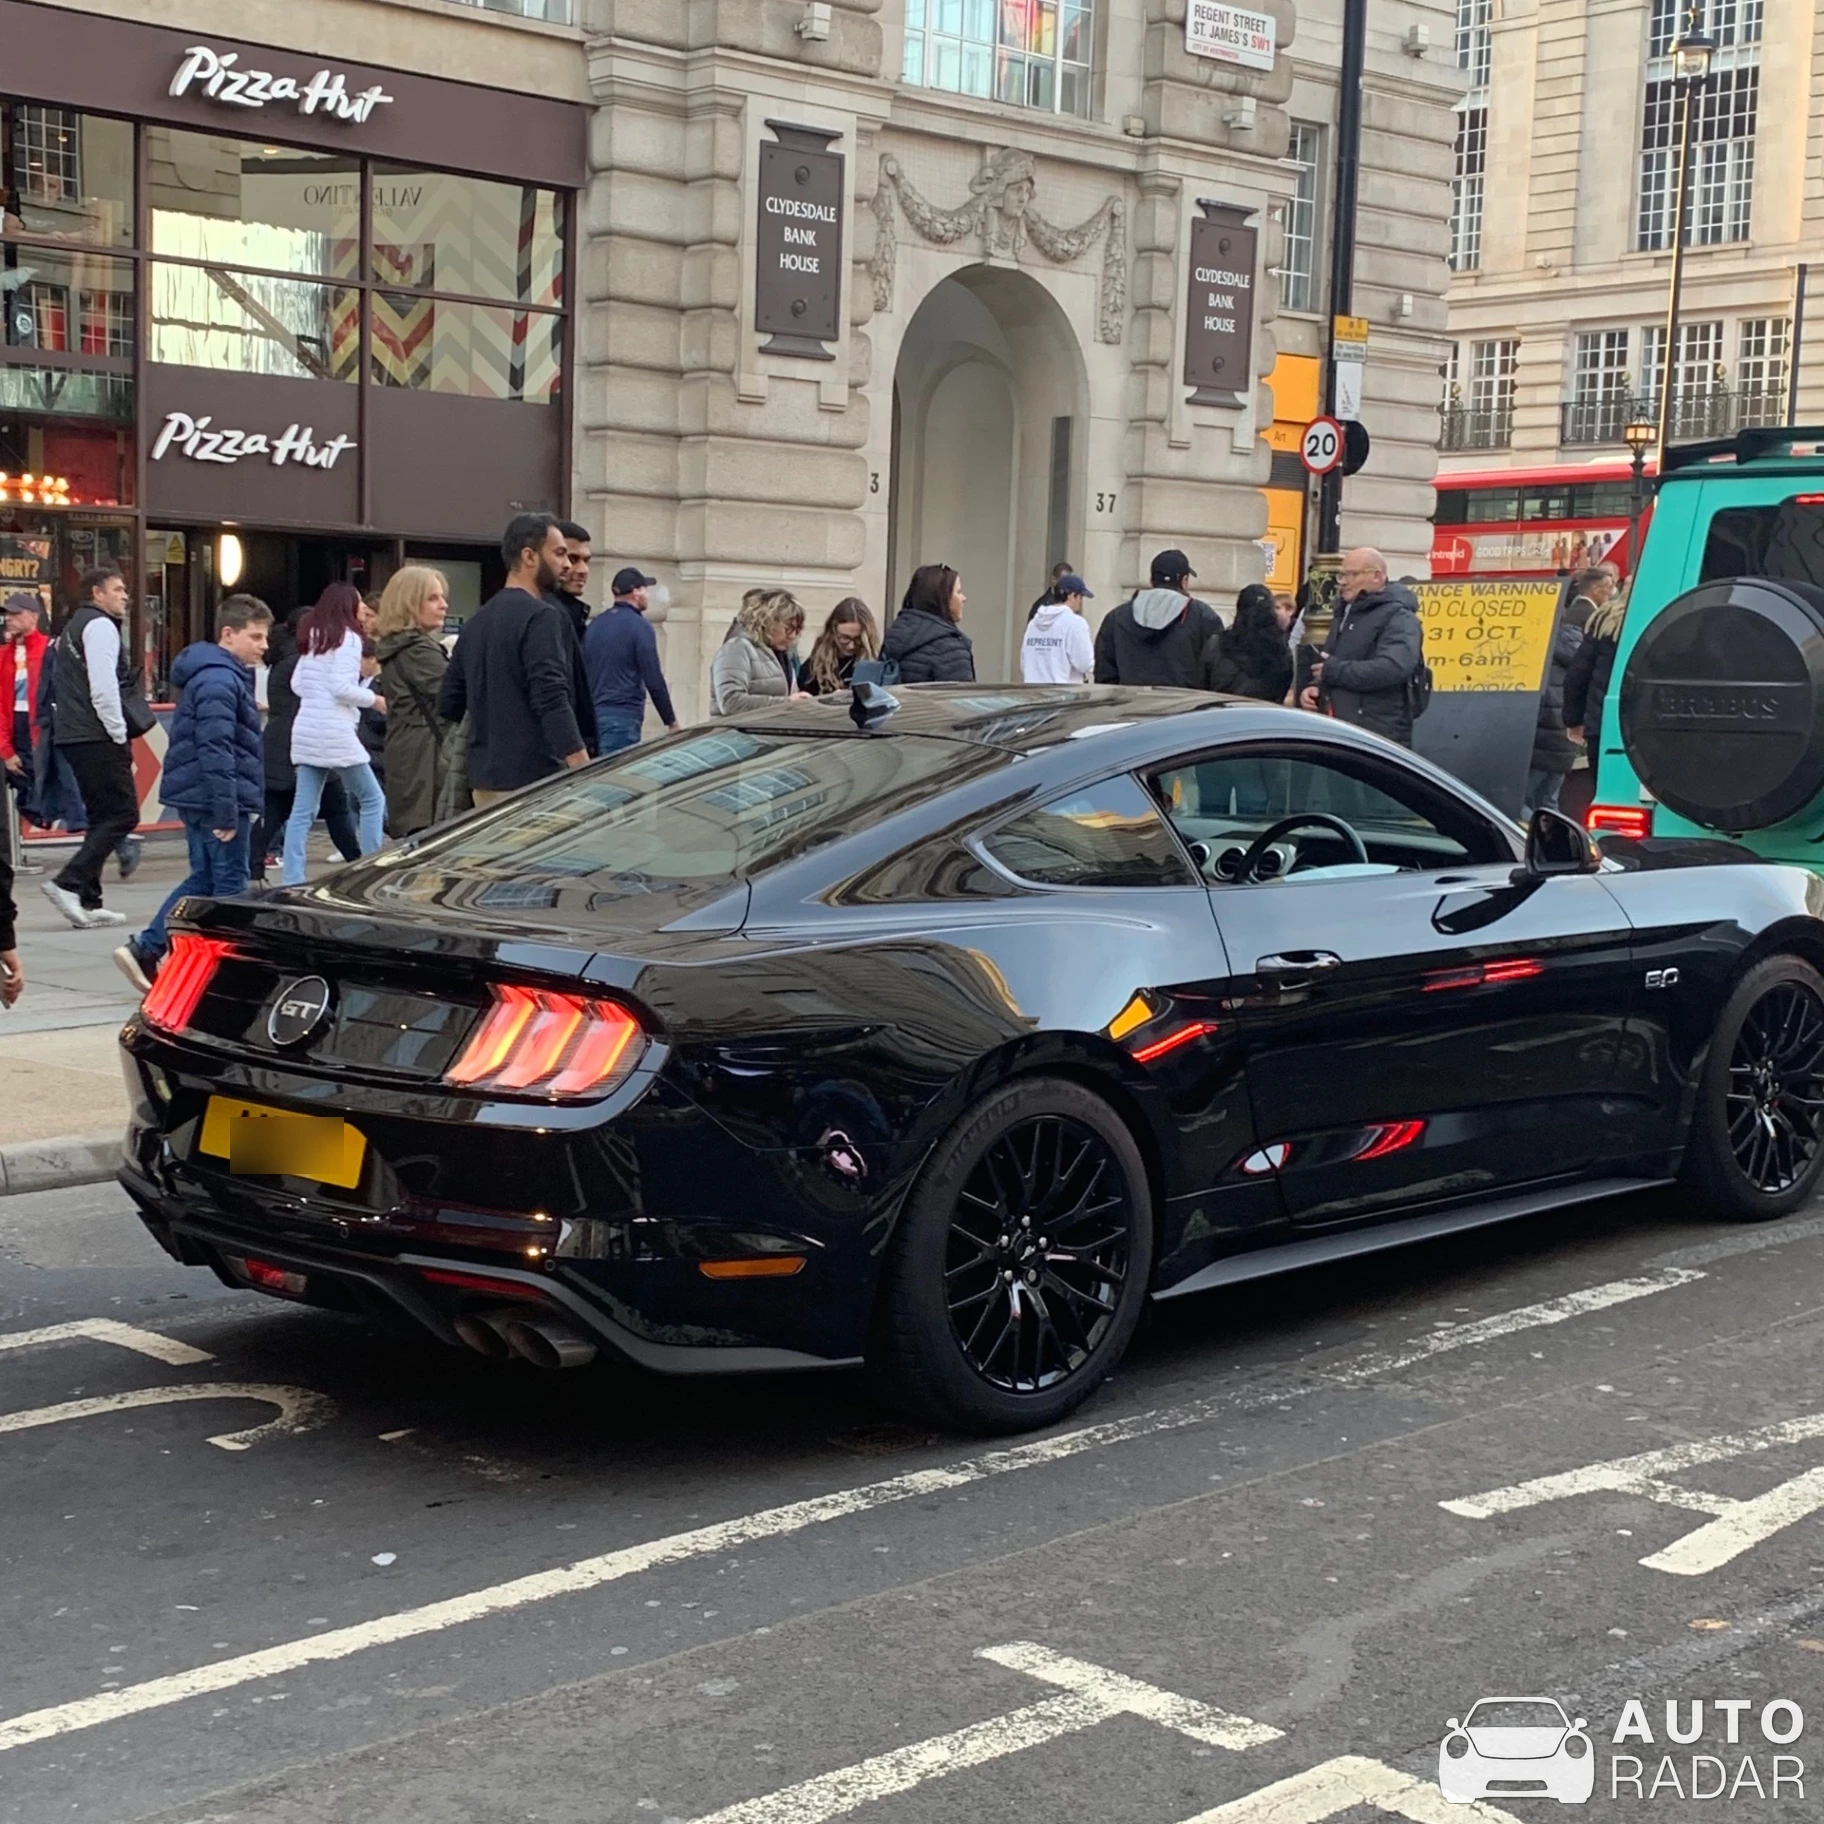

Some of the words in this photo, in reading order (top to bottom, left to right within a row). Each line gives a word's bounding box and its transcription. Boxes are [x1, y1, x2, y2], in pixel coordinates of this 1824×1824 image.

[1194, 4, 1230, 25] REGENT
[1233, 13, 1267, 34] STREET
[1193, 20, 1206, 37] ST.
[1209, 25, 1249, 46] JAMES'S
[1251, 35, 1270, 52] SW1
[169, 46, 300, 107] Pizza
[299, 70, 394, 123] Hut
[765, 195, 837, 223] CLYDESDALE
[784, 226, 817, 247] BANK
[780, 252, 820, 274] HOUSE
[1195, 267, 1250, 289] CLYDESDALE
[1208, 292, 1235, 310] BANK
[1204, 315, 1236, 333] HOUSE
[151, 412, 270, 463] Pizza
[270, 424, 358, 469] Hut
[1306, 433, 1336, 457] 20
[870, 472, 880, 494] 3
[1095, 493, 1117, 513] 37
[1410, 585, 1464, 598] ANCE
[1471, 583, 1558, 597] WARNING
[1446, 600, 1527, 618] CLOSED
[1428, 627, 1455, 641] 31
[1465, 626, 1523, 641] OCT
[281, 1000, 321, 1019] GT
